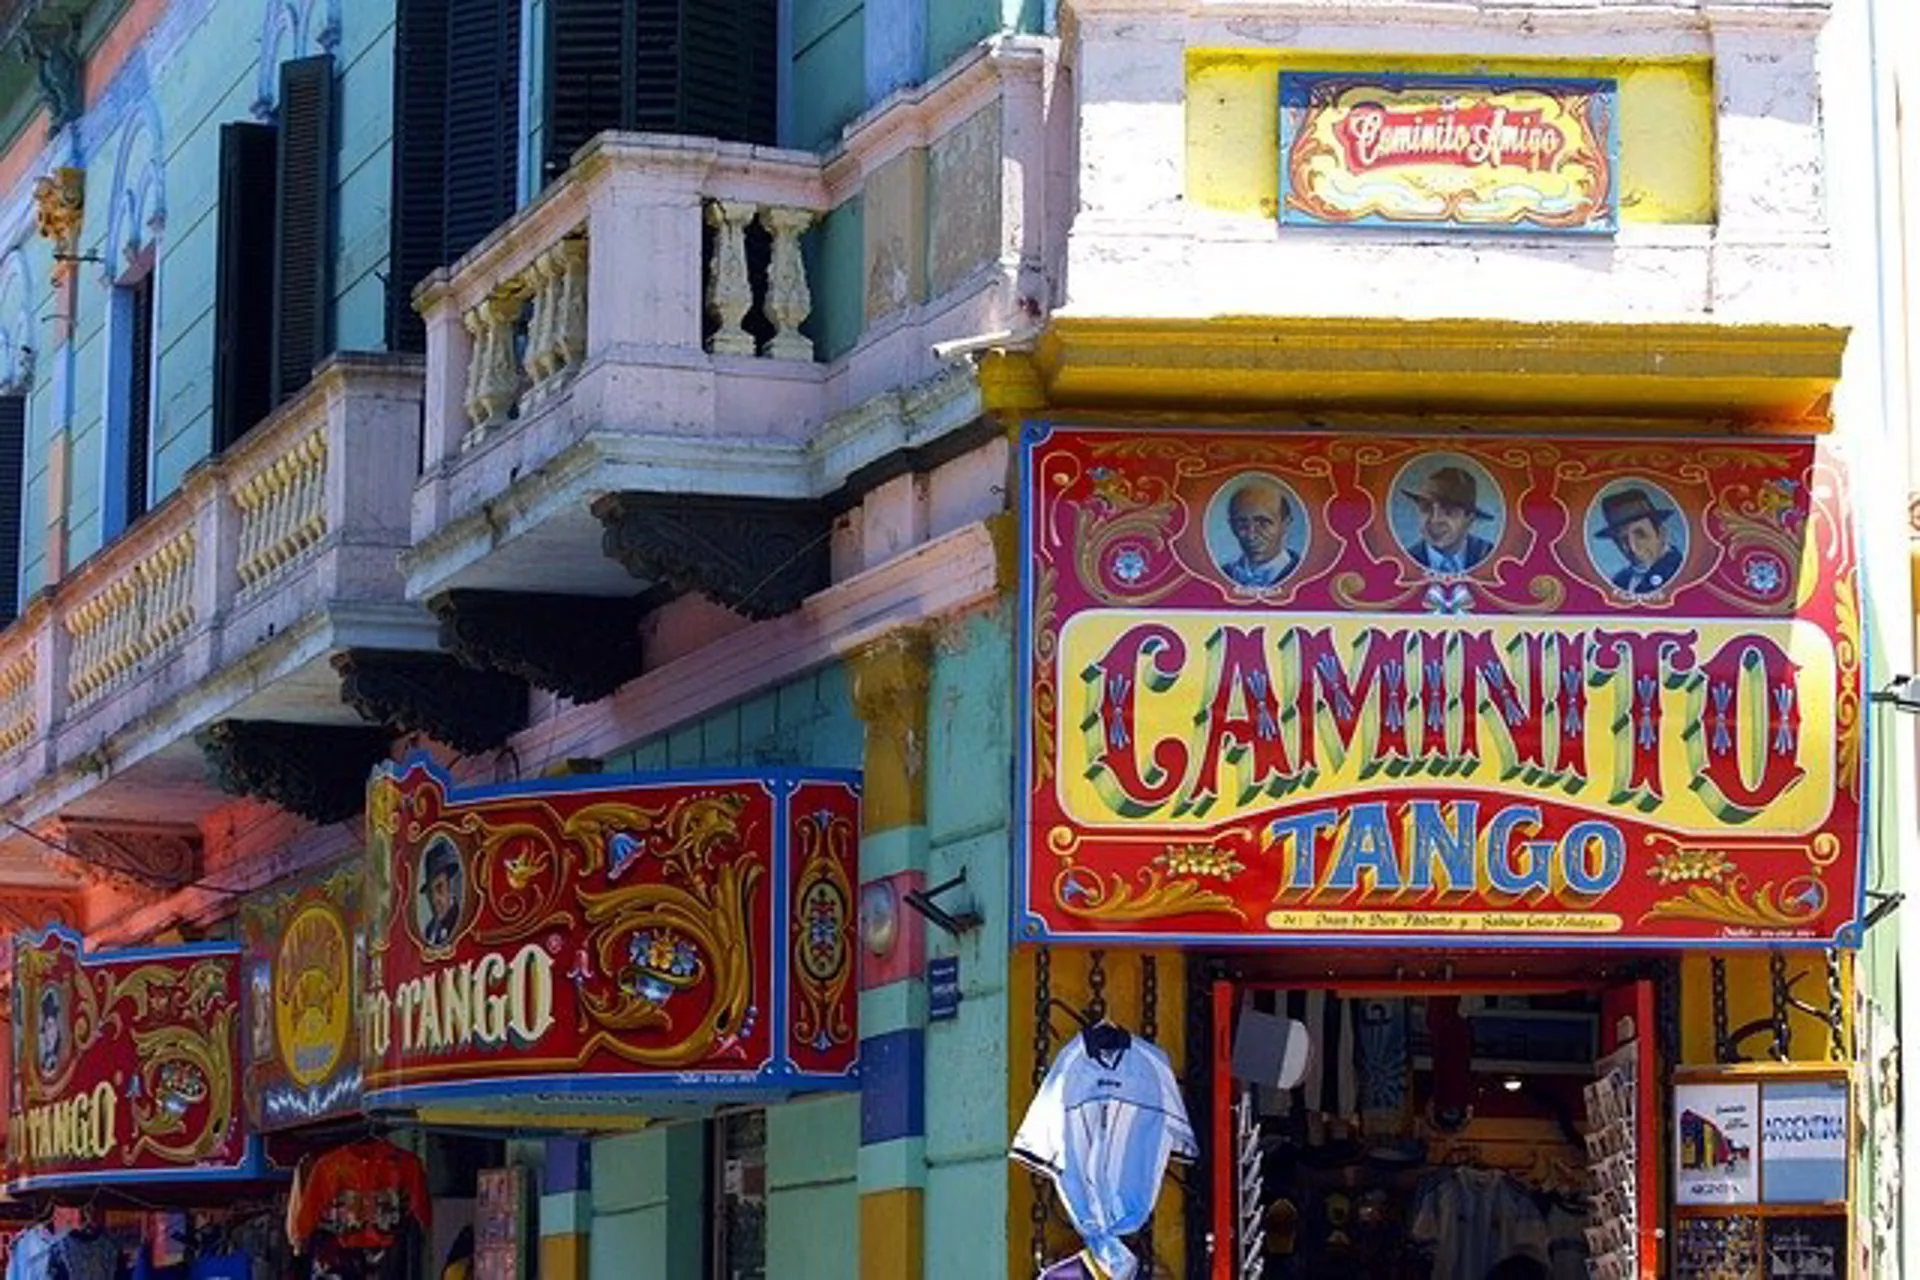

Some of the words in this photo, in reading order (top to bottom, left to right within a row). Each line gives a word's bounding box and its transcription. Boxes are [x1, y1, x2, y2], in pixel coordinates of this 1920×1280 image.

[1467, 108, 1560, 173] Amigo
[1080, 622, 1806, 825] CAMINITO
[1264, 799, 1626, 904] TANGO
[397, 943, 556, 1056] TANGO
[28, 1080, 117, 1161] TANGO
